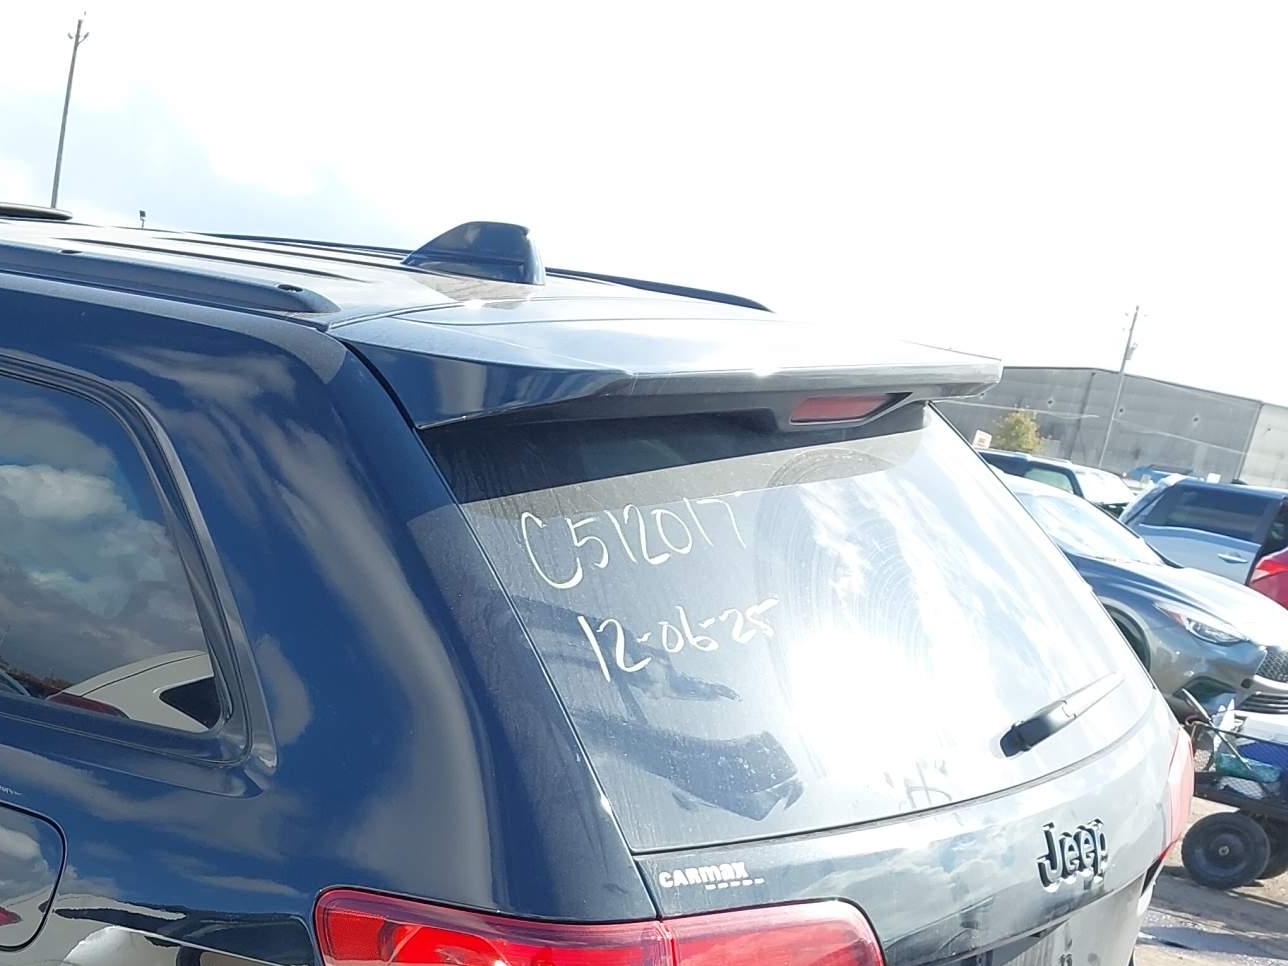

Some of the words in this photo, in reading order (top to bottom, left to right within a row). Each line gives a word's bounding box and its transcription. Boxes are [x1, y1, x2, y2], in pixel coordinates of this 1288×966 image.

[521, 497, 747, 589] C512017
[577, 598, 779, 683] 12-06-25
[1035, 817, 1108, 893] Jeep
